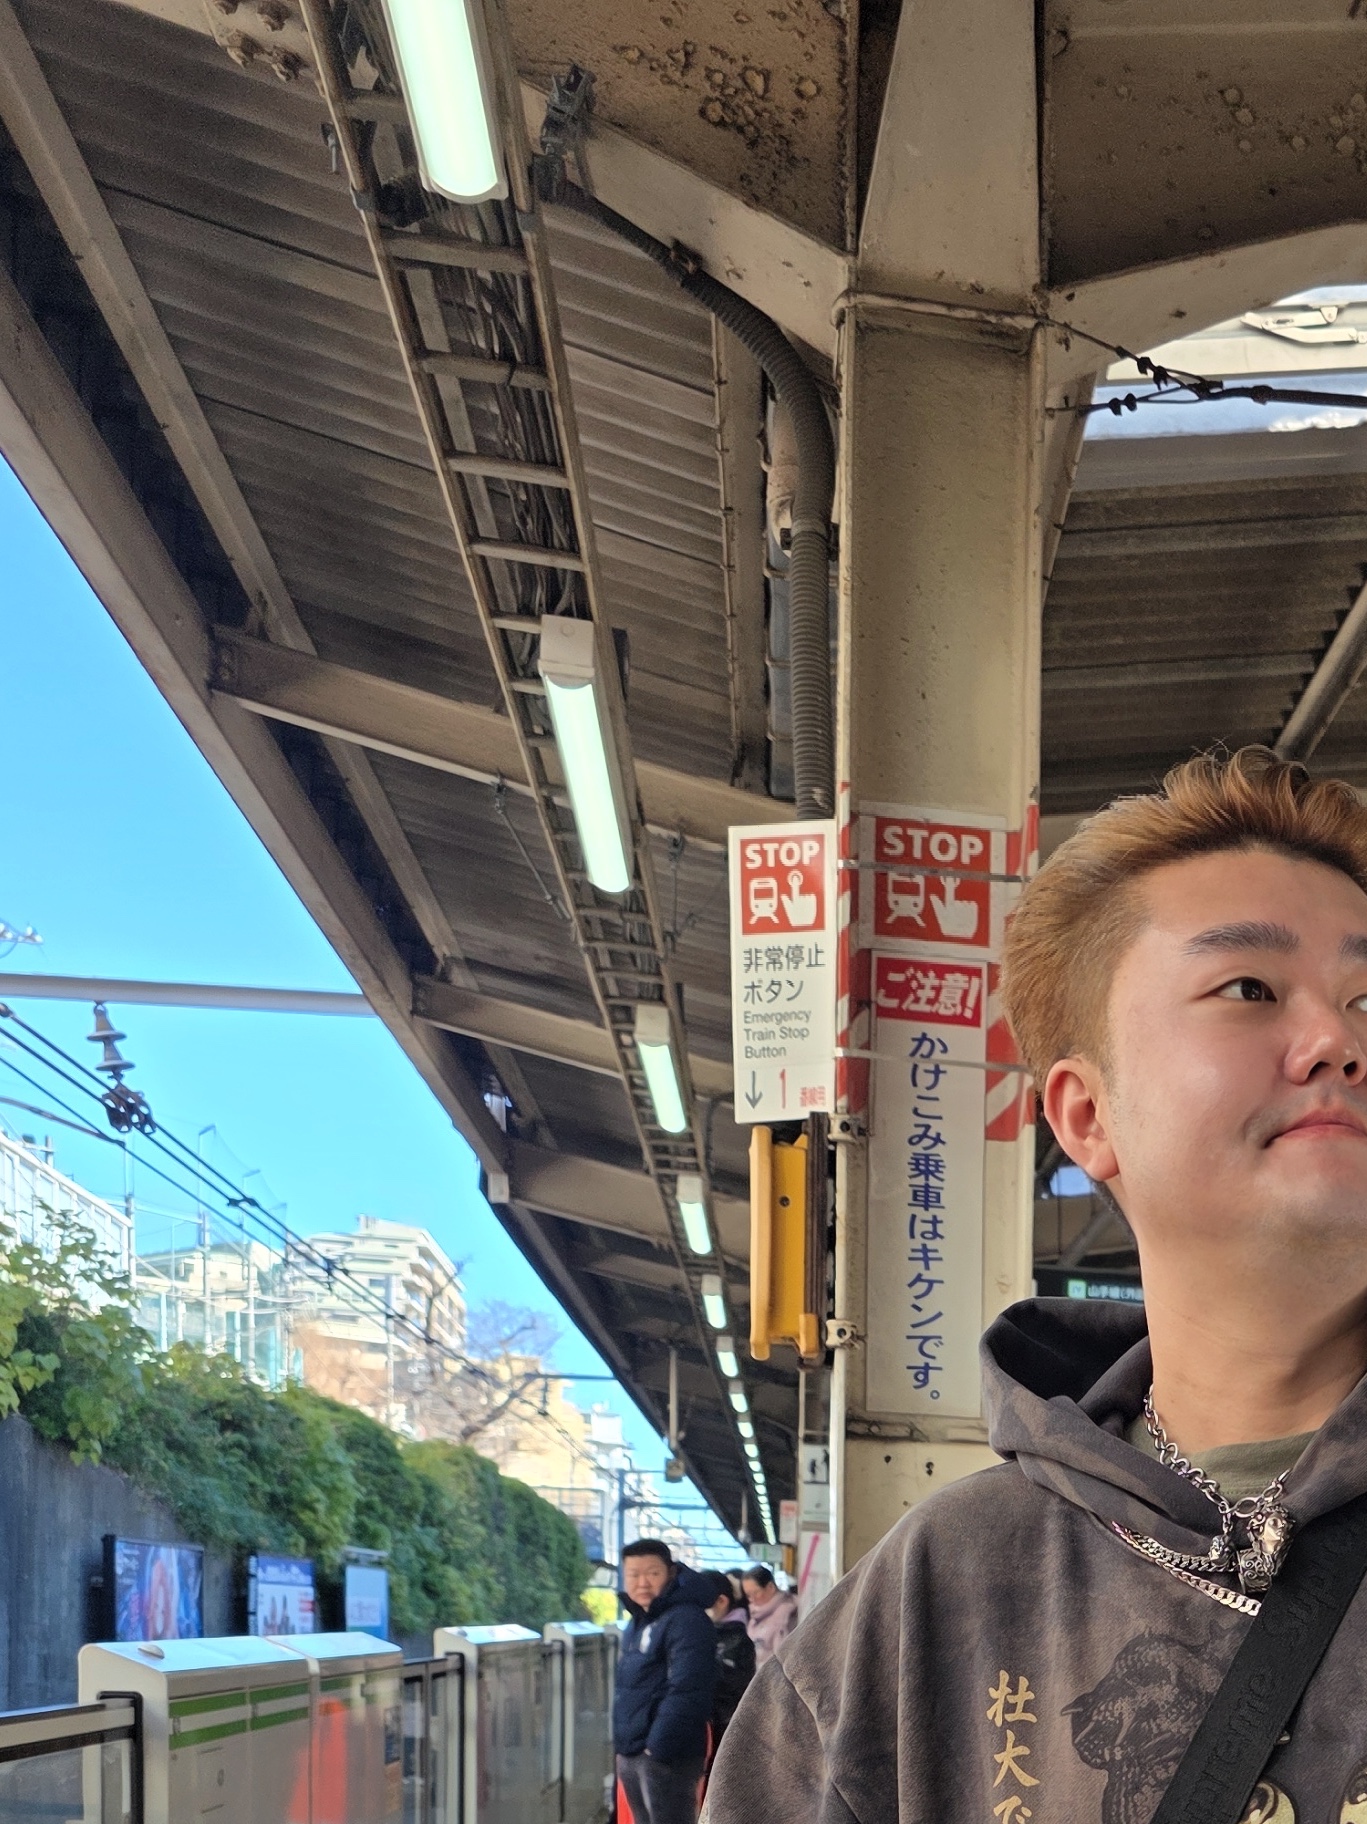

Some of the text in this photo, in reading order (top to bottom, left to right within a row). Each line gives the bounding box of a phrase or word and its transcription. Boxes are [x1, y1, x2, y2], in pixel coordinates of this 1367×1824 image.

[745, 840, 820, 869] STOP
[883, 826, 984, 864] STOP
[743, 942, 826, 973] 非常停止
[744, 979, 804, 1005] ボタン
[743, 1010, 812, 1026] Emergency
[744, 1026, 810, 1042] Train Stop
[744, 1046, 787, 1059] Button
[906, 1031, 948, 1400] かけこみ乗車はキケンです。
